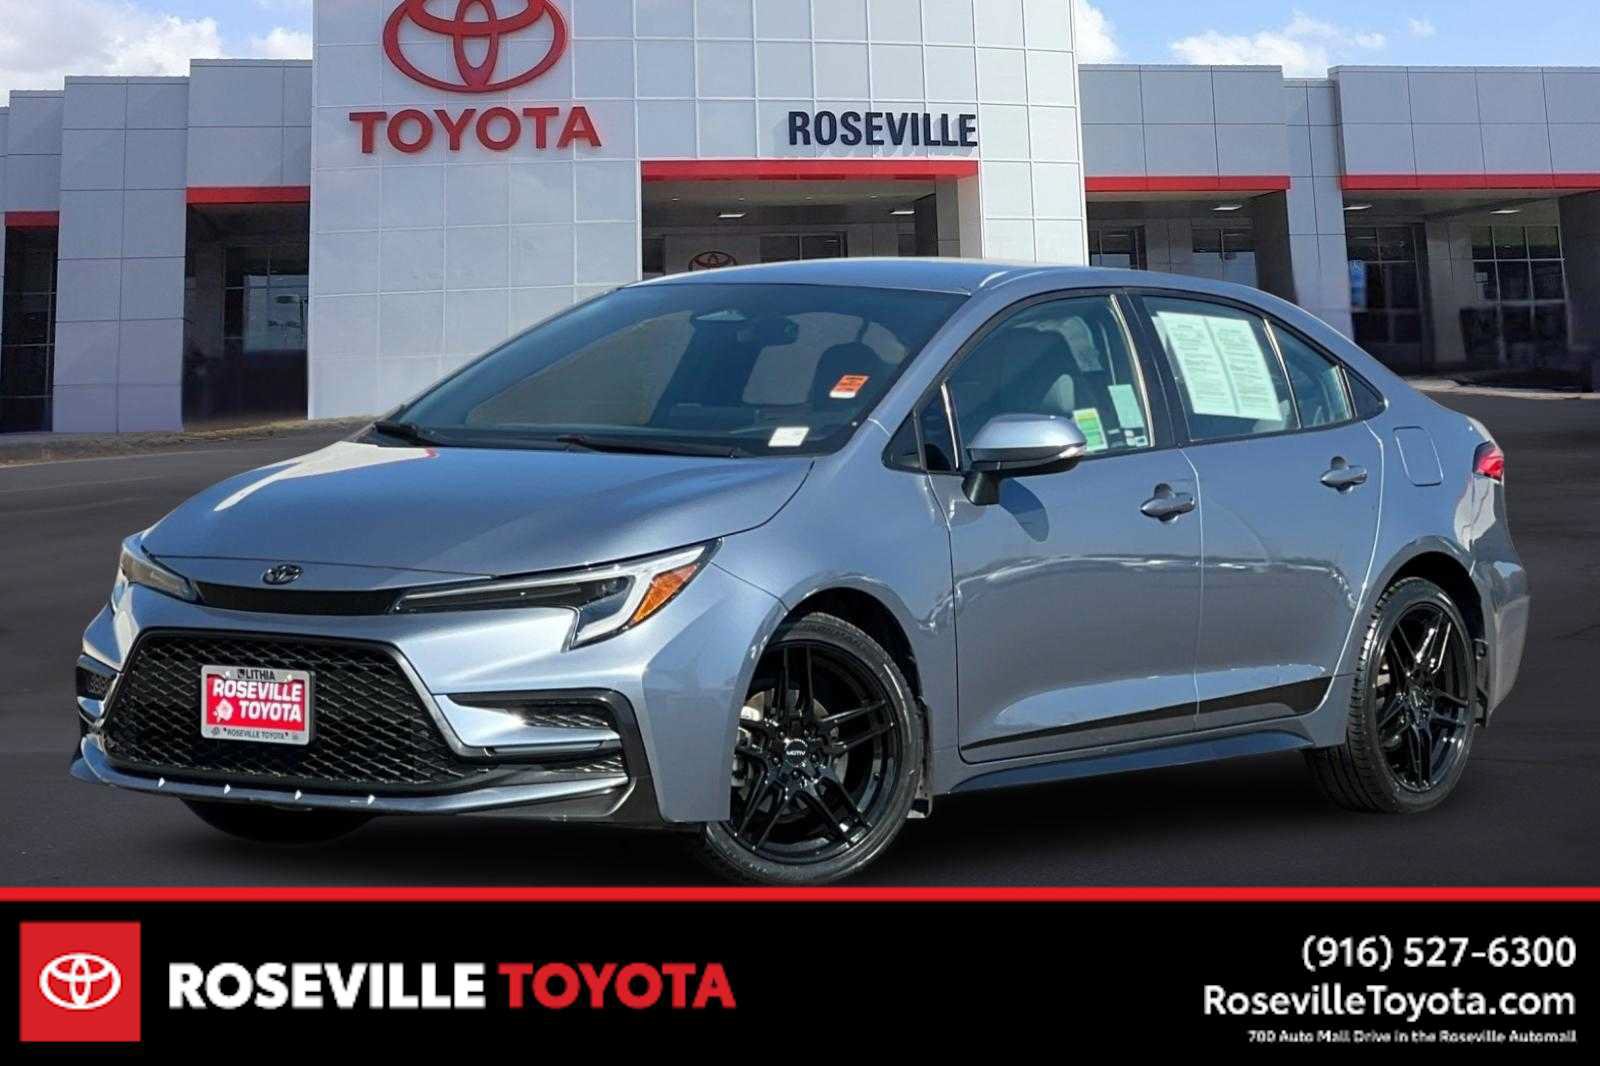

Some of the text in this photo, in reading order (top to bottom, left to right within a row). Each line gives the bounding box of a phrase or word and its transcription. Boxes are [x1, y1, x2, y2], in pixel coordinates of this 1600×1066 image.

[349, 106, 602, 154] TOYOTA
[788, 110, 978, 147] ROSEVILLE
[246, 669, 275, 681] LITHIA
[213, 679, 303, 702] ROSEVILLE
[238, 700, 302, 723] TOYOTA
[226, 728, 285, 739] ROSEVILLE TOYOTA
